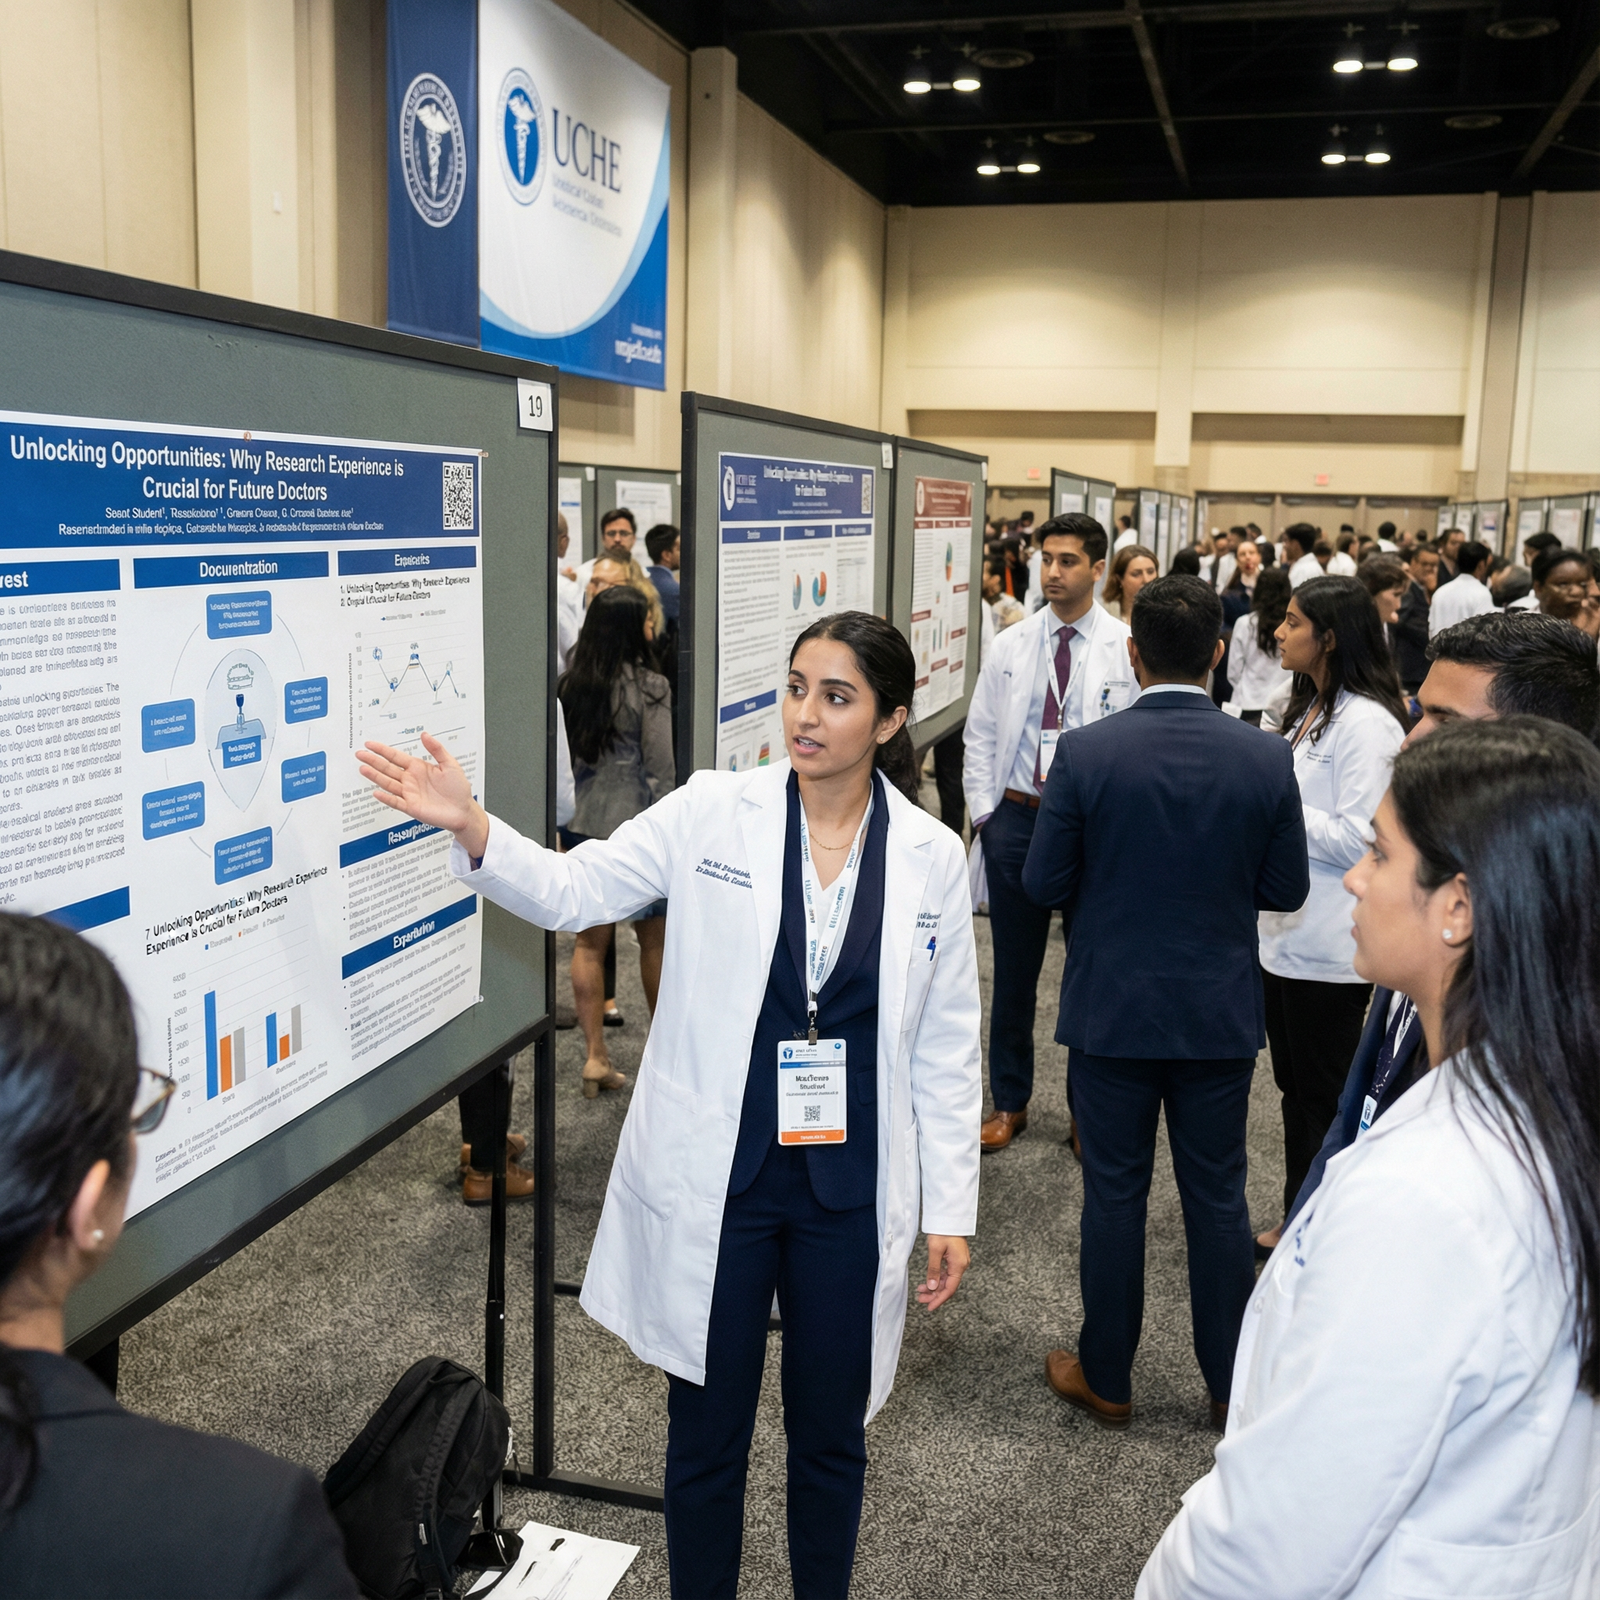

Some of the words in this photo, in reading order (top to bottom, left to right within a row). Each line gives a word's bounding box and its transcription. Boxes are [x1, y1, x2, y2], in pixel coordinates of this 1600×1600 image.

[552, 107, 622, 194] UCHE
[528, 395, 543, 418] 19
[10, 434, 107, 469] Unlocking
[111, 440, 227, 470] Opportunities:
[229, 448, 262, 475] Why
[266, 450, 326, 473] Research
[329, 454, 392, 478] Experience
[394, 458, 404, 477] is
[142, 475, 199, 499] Crucial
[203, 477, 226, 499] for
[229, 478, 275, 500] Future
[278, 480, 328, 501] Doctors
